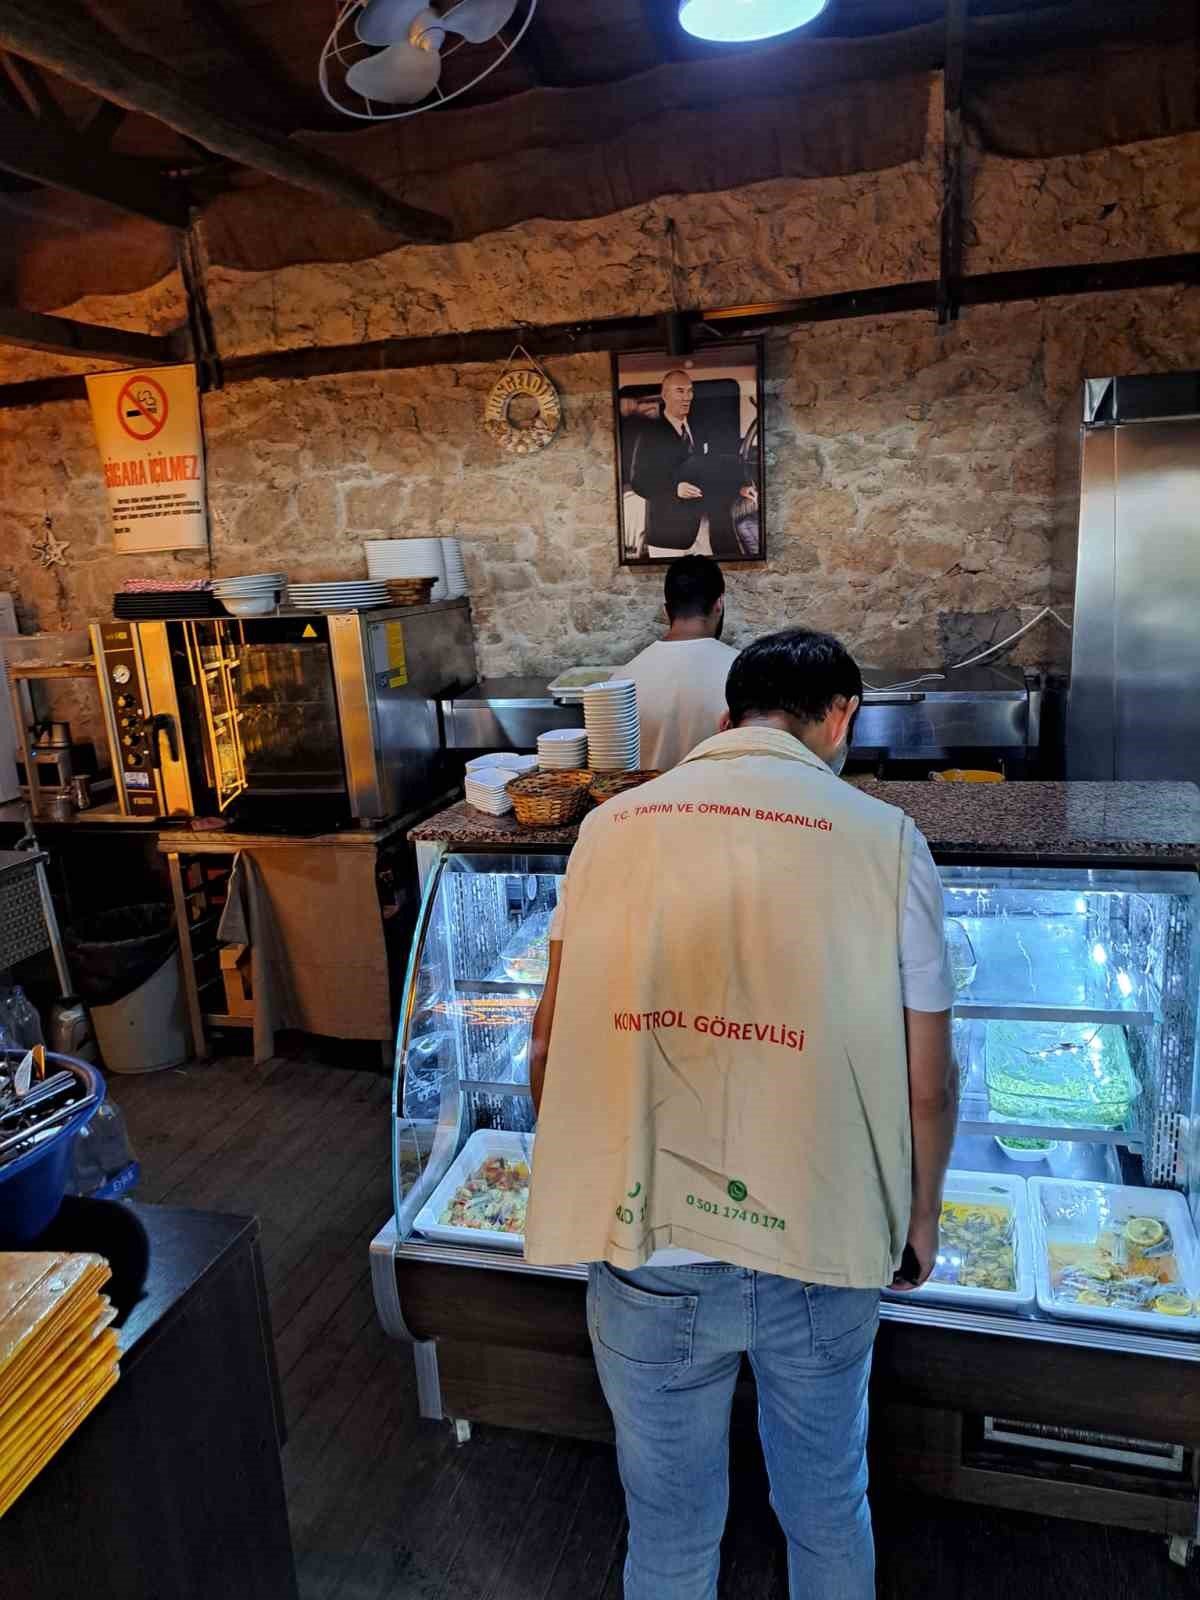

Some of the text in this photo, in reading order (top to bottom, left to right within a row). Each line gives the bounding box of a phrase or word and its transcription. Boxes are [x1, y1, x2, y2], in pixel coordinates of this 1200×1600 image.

[634, 803, 673, 816] TARIM
[676, 803, 695, 814] VE
[698, 803, 751, 817] ORMAN
[755, 808, 833, 832] BAKANLIĞI
[614, 1009, 805, 1051] KONTROL GÖREVLİSİ
[686, 1194, 786, 1232] 0 501 174 0 174
